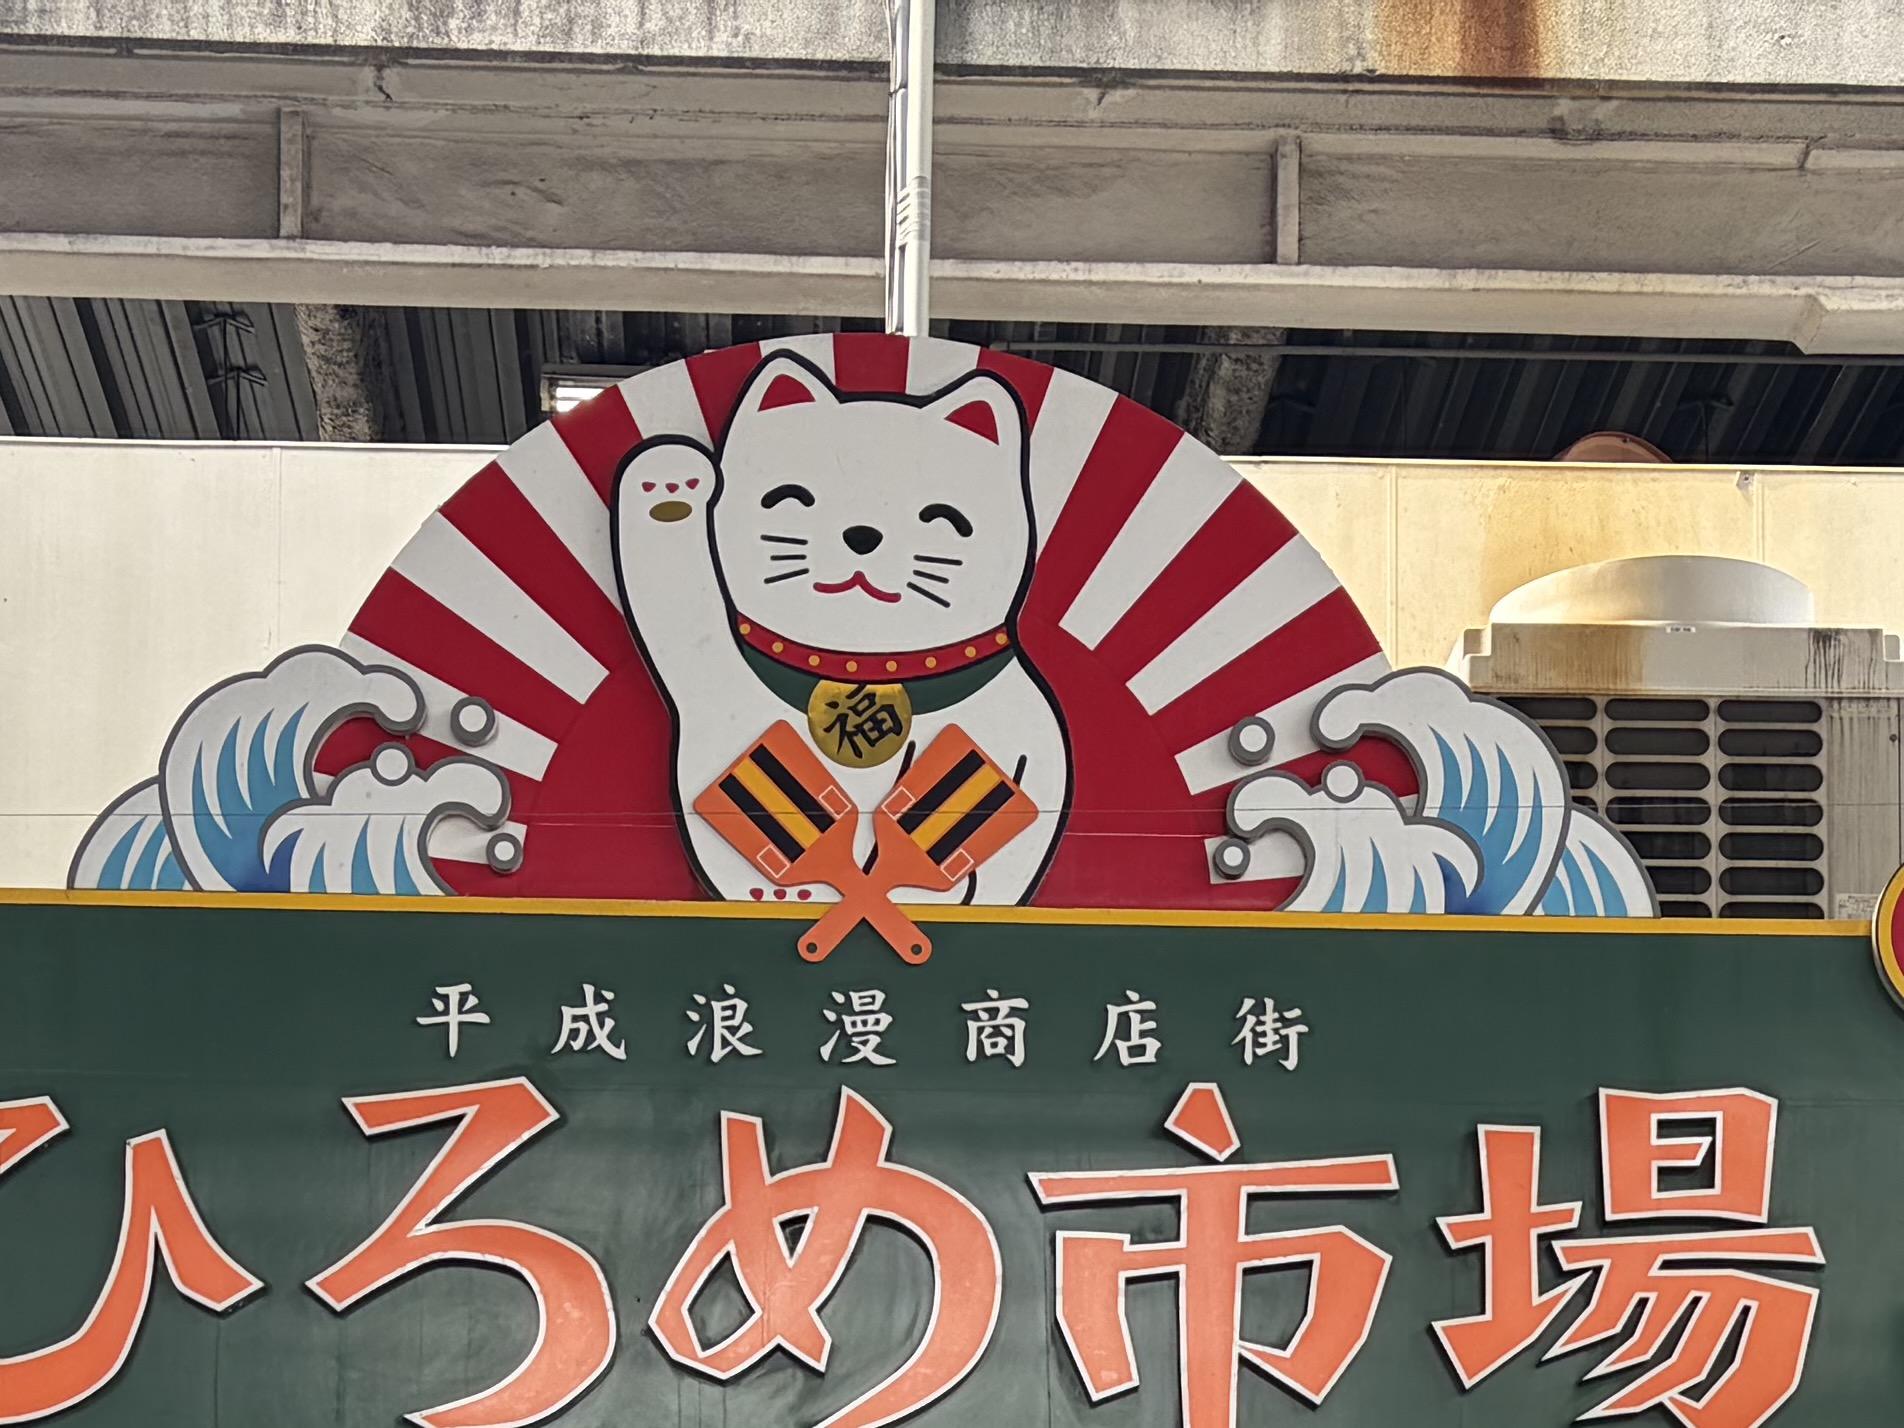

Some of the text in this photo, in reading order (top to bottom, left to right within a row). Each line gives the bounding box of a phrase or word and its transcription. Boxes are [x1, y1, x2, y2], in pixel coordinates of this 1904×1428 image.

[823, 683, 904, 759] 福
[416, 983, 1311, 1076] 平成浪漫商店街
